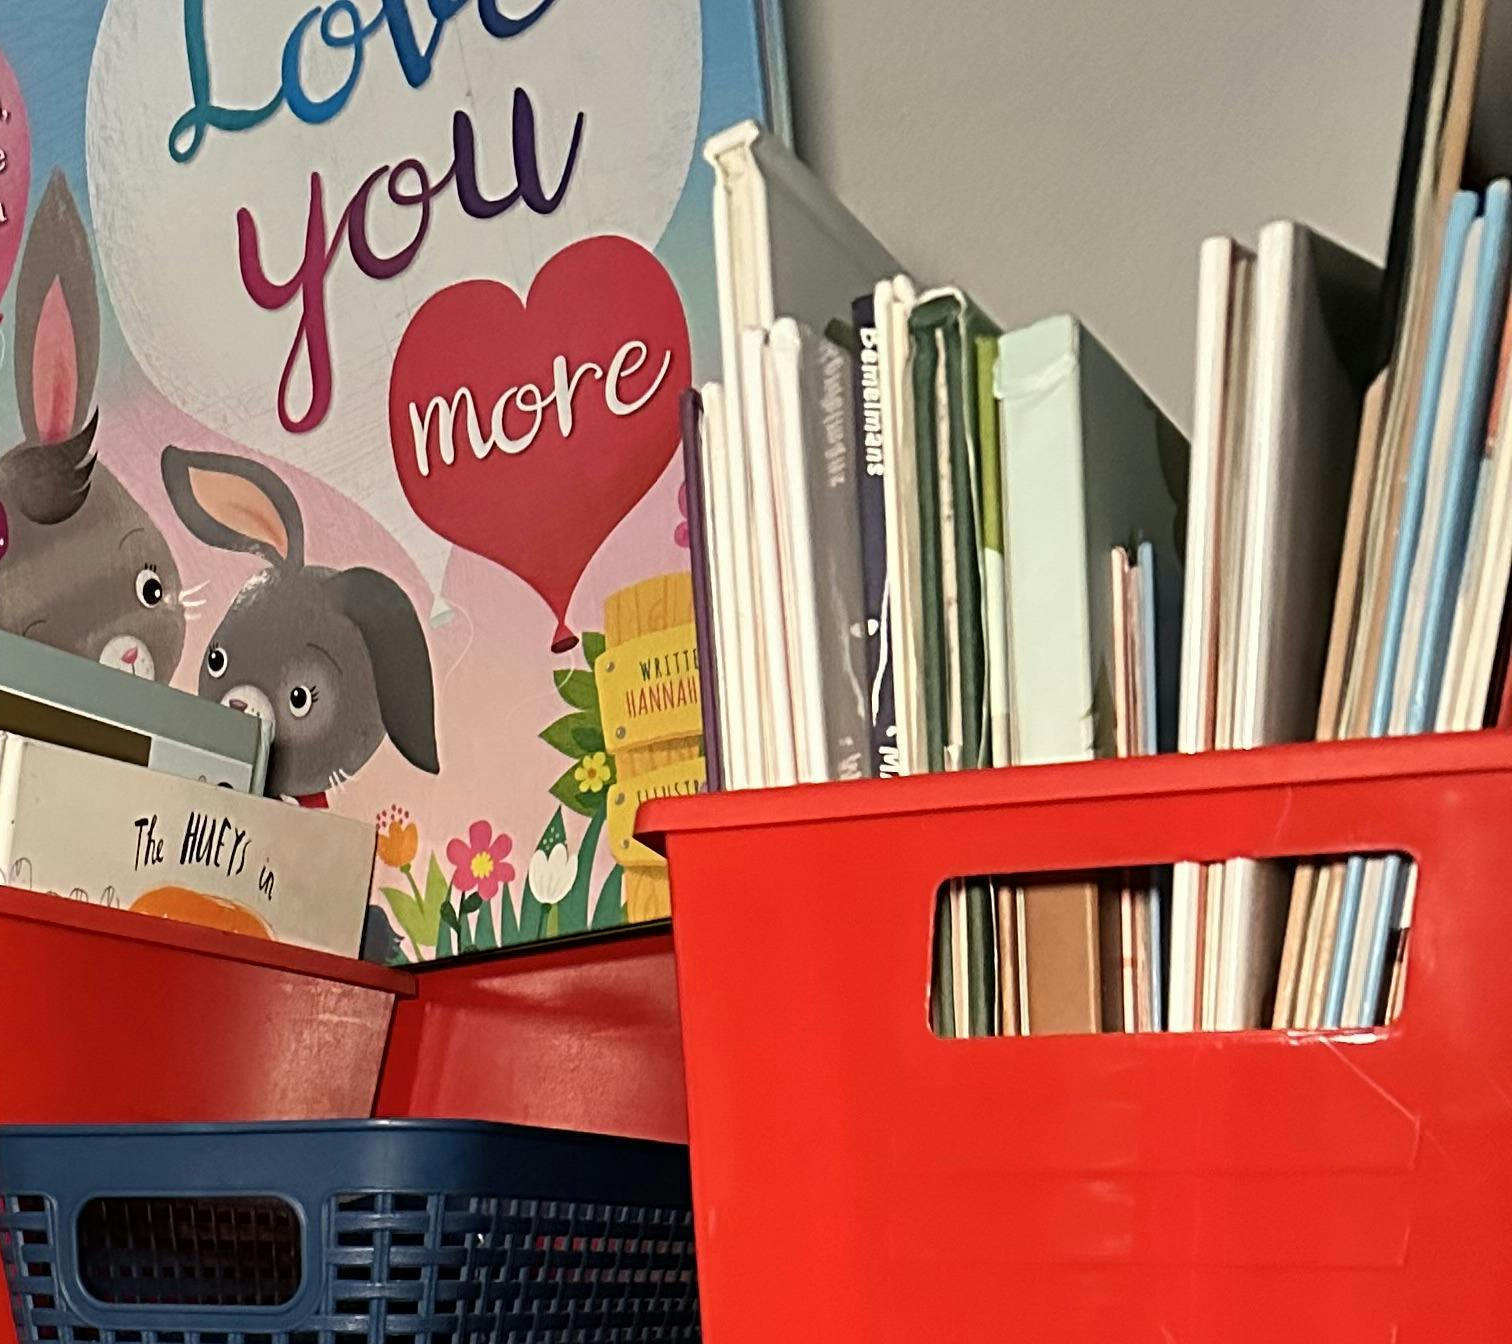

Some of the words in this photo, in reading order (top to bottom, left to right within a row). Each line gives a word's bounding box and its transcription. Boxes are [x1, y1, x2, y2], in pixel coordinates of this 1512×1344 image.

[237, 87, 584, 433] you
[409, 340, 670, 476] more
[626, 675, 698, 719] HANNAH
[640, 648, 699, 681] WRITTE
[134, 814, 165, 871] The
[180, 811, 253, 877] HUEYS
[258, 857, 275, 901] in
